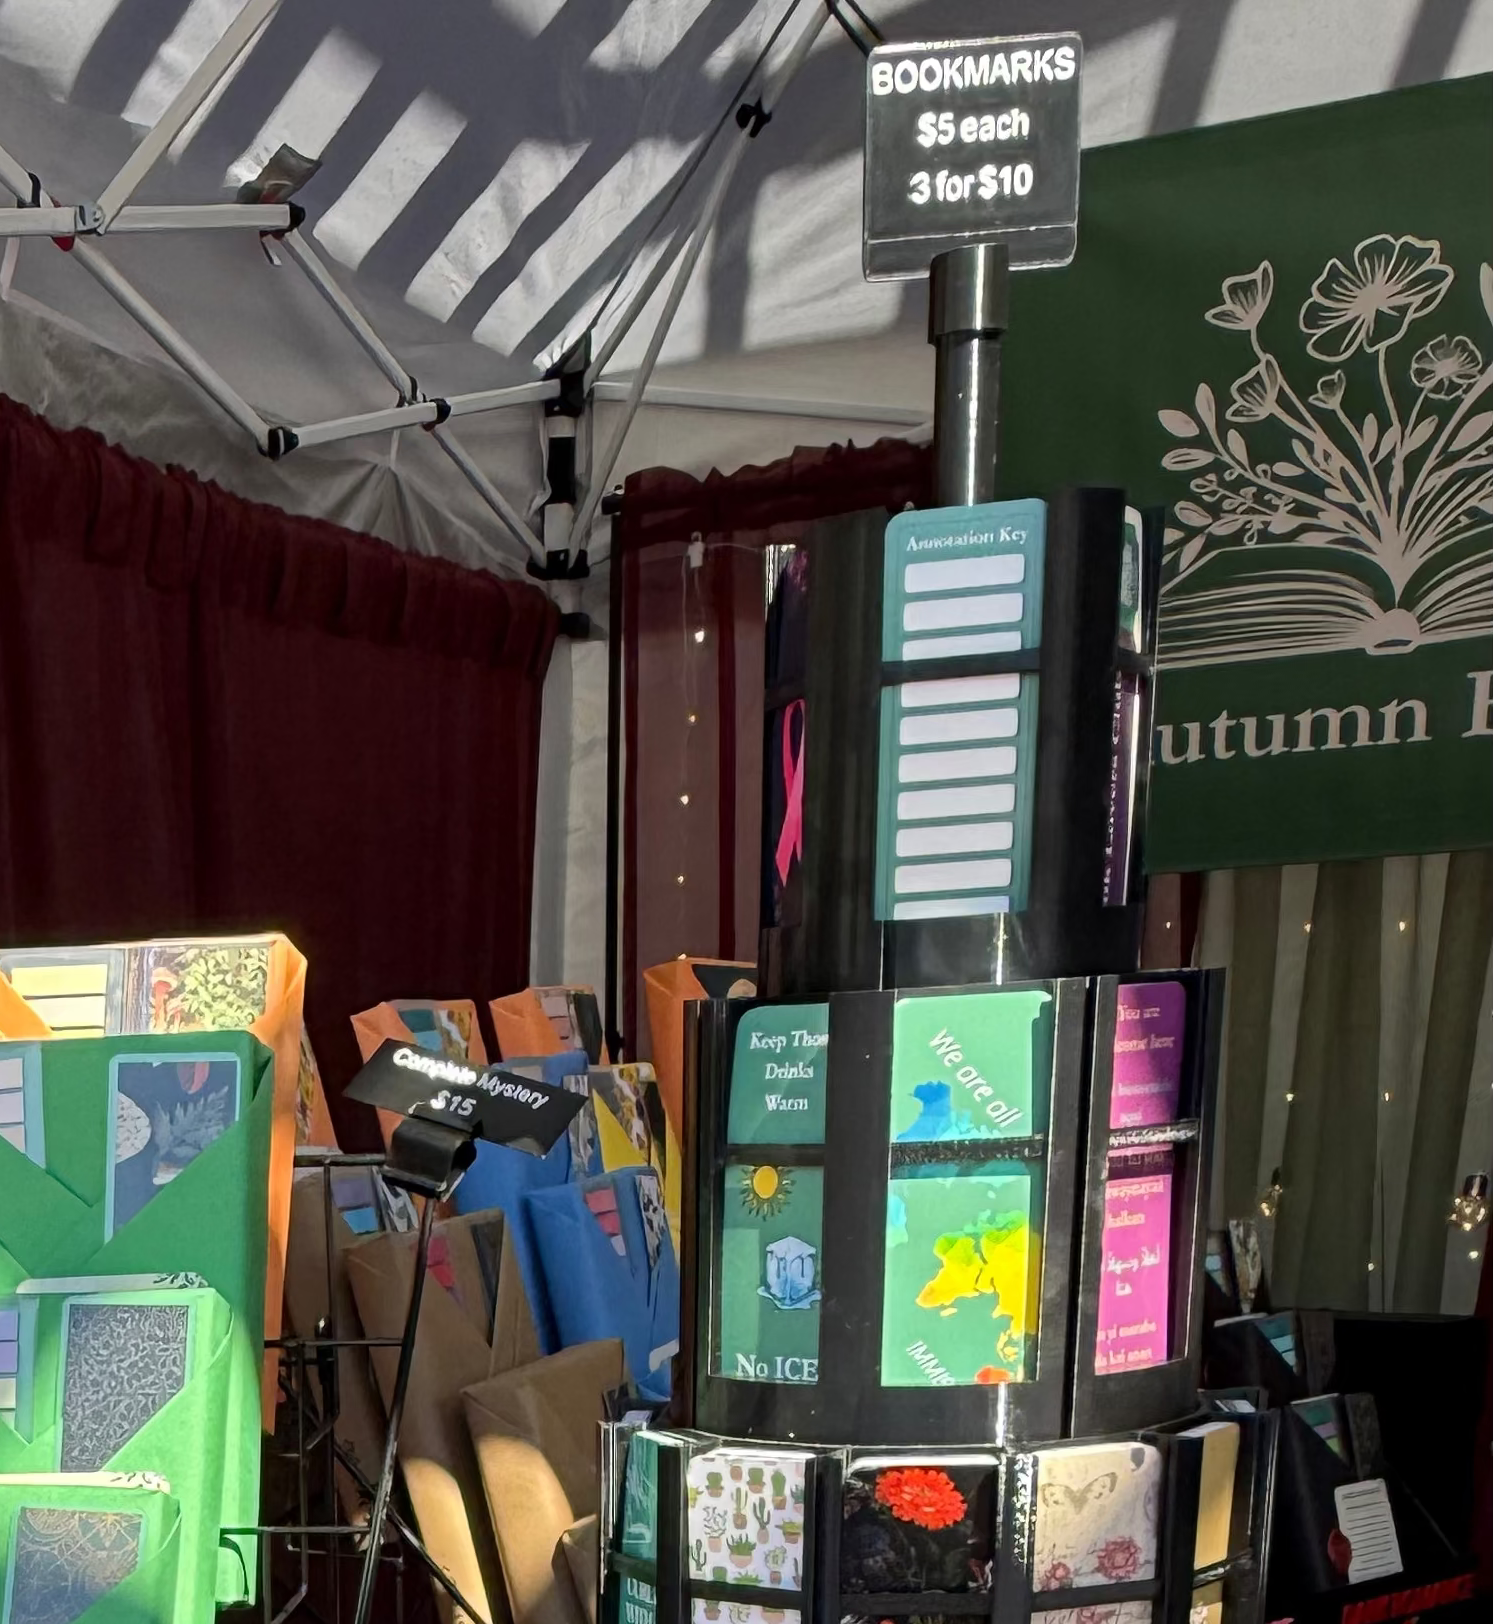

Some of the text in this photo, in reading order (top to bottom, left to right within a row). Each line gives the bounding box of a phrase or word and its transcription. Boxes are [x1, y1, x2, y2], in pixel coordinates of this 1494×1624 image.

[871, 46, 1076, 96] BOOKMARKS
[916, 108, 1030, 148] $5 each
[907, 163, 1034, 205] 3 for $10
[906, 526, 1028, 551] Annotation Key
[1155, 698, 1432, 765] utumn
[749, 1031, 787, 1053] Keep
[392, 1047, 551, 1110] Complete Mystery
[765, 1061, 814, 1080] Drinks
[928, 1026, 1023, 1128] We are all
[429, 1089, 477, 1117] $15
[765, 1094, 808, 1112] Warm
[735, 1353, 819, 1382] No ICE
